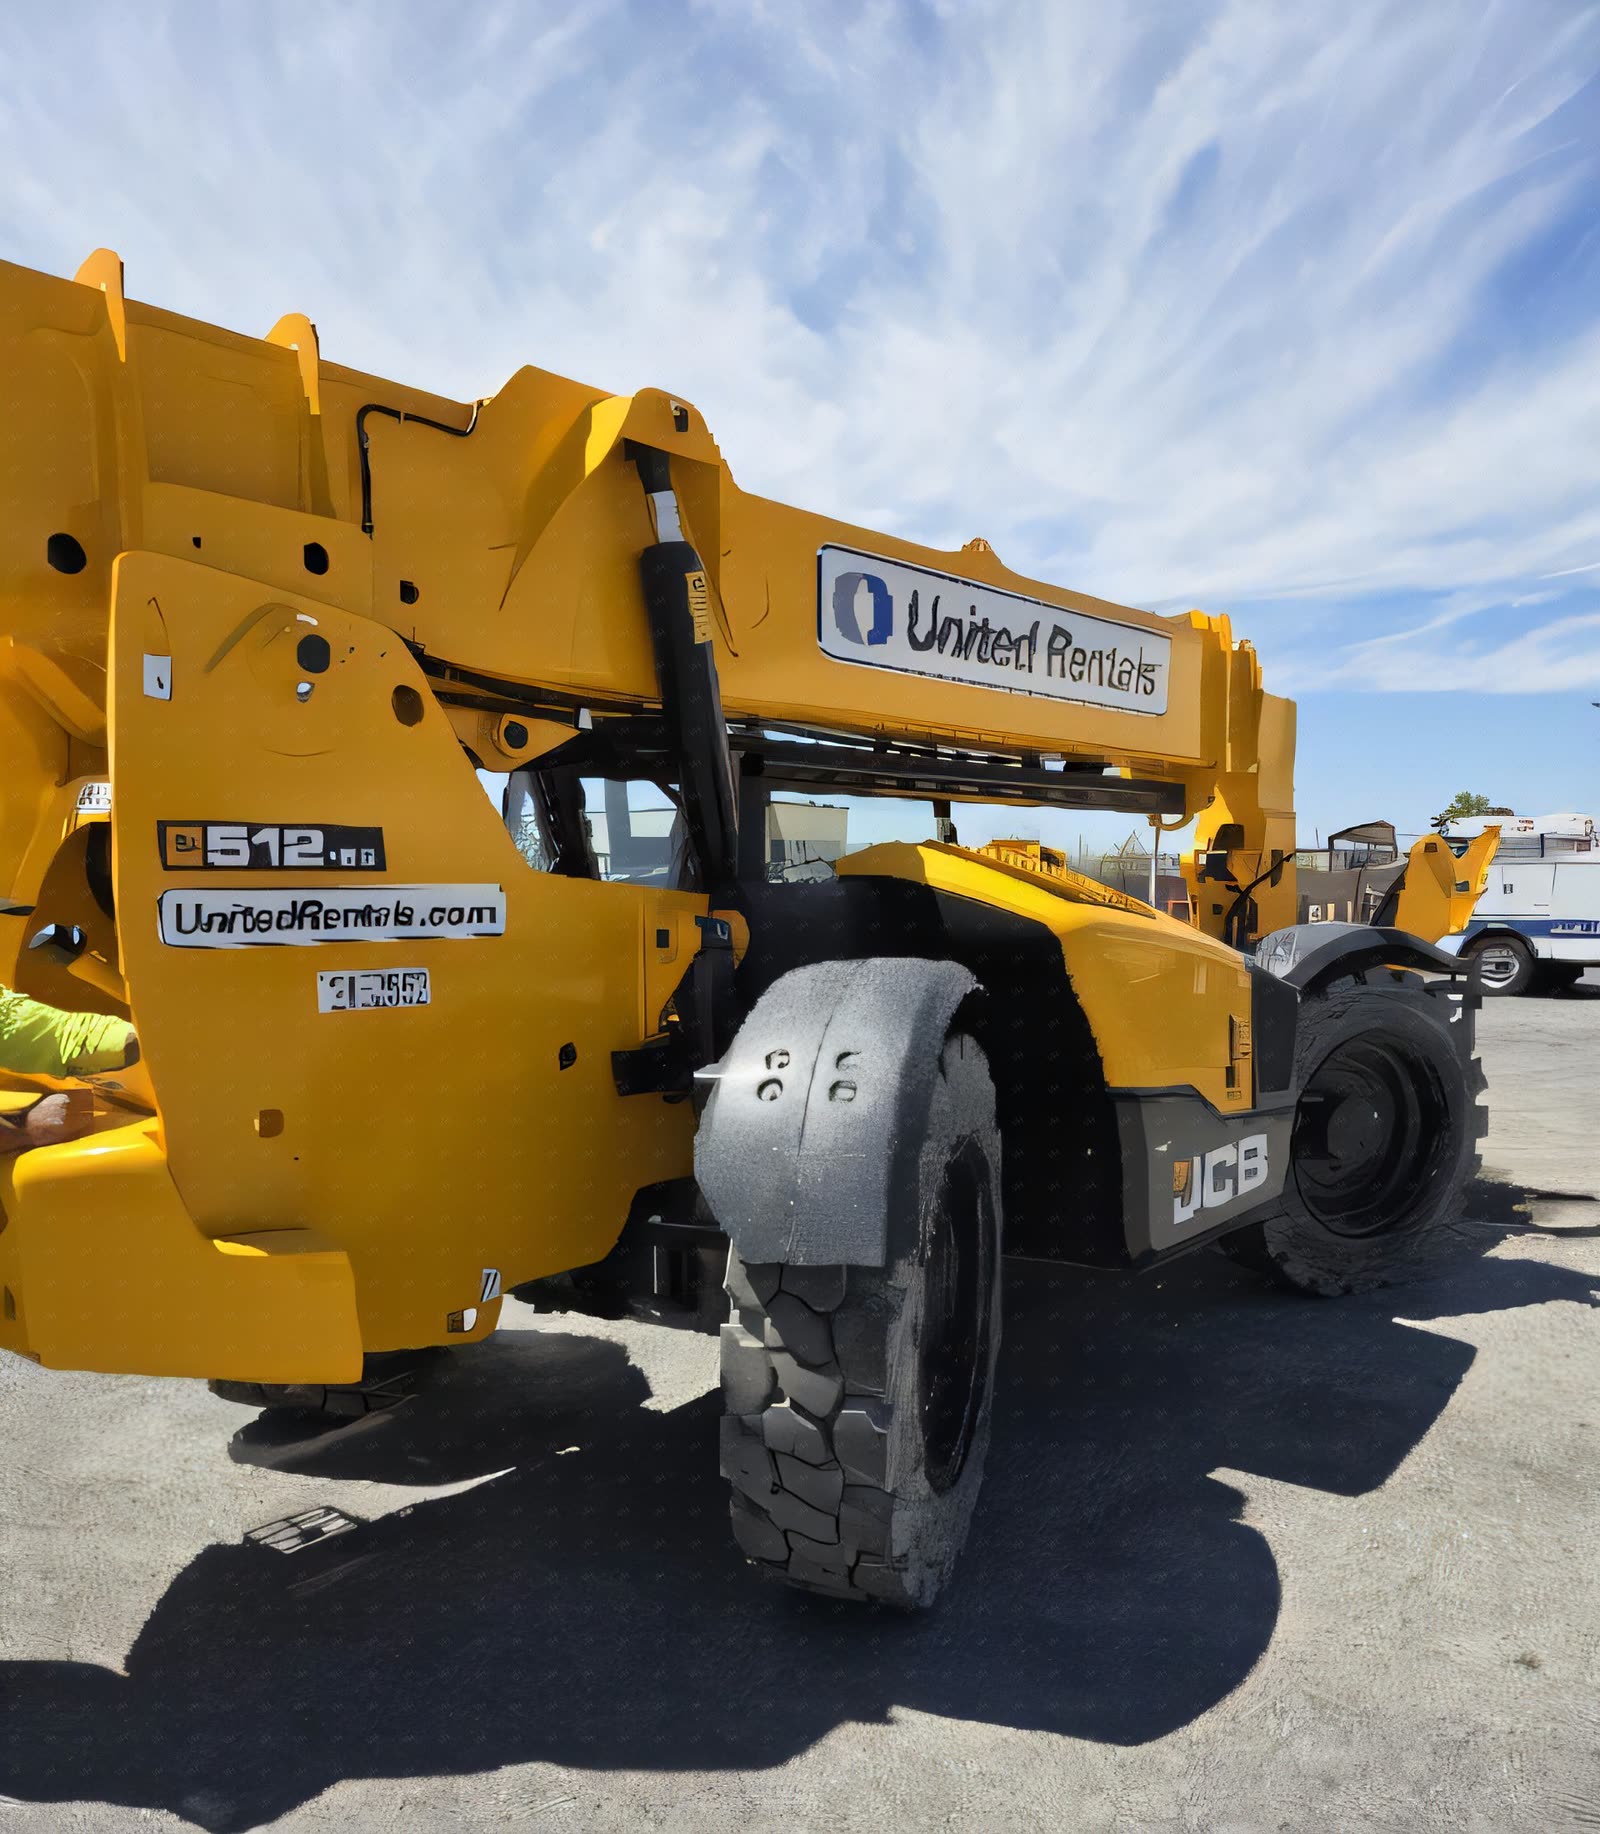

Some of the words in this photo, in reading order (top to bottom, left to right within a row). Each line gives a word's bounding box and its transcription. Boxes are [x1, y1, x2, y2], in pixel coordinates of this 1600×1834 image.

[907, 589, 1041, 674] United
[1047, 624, 1162, 696] Rentals
[1174, 1133, 1268, 1224] JCB
